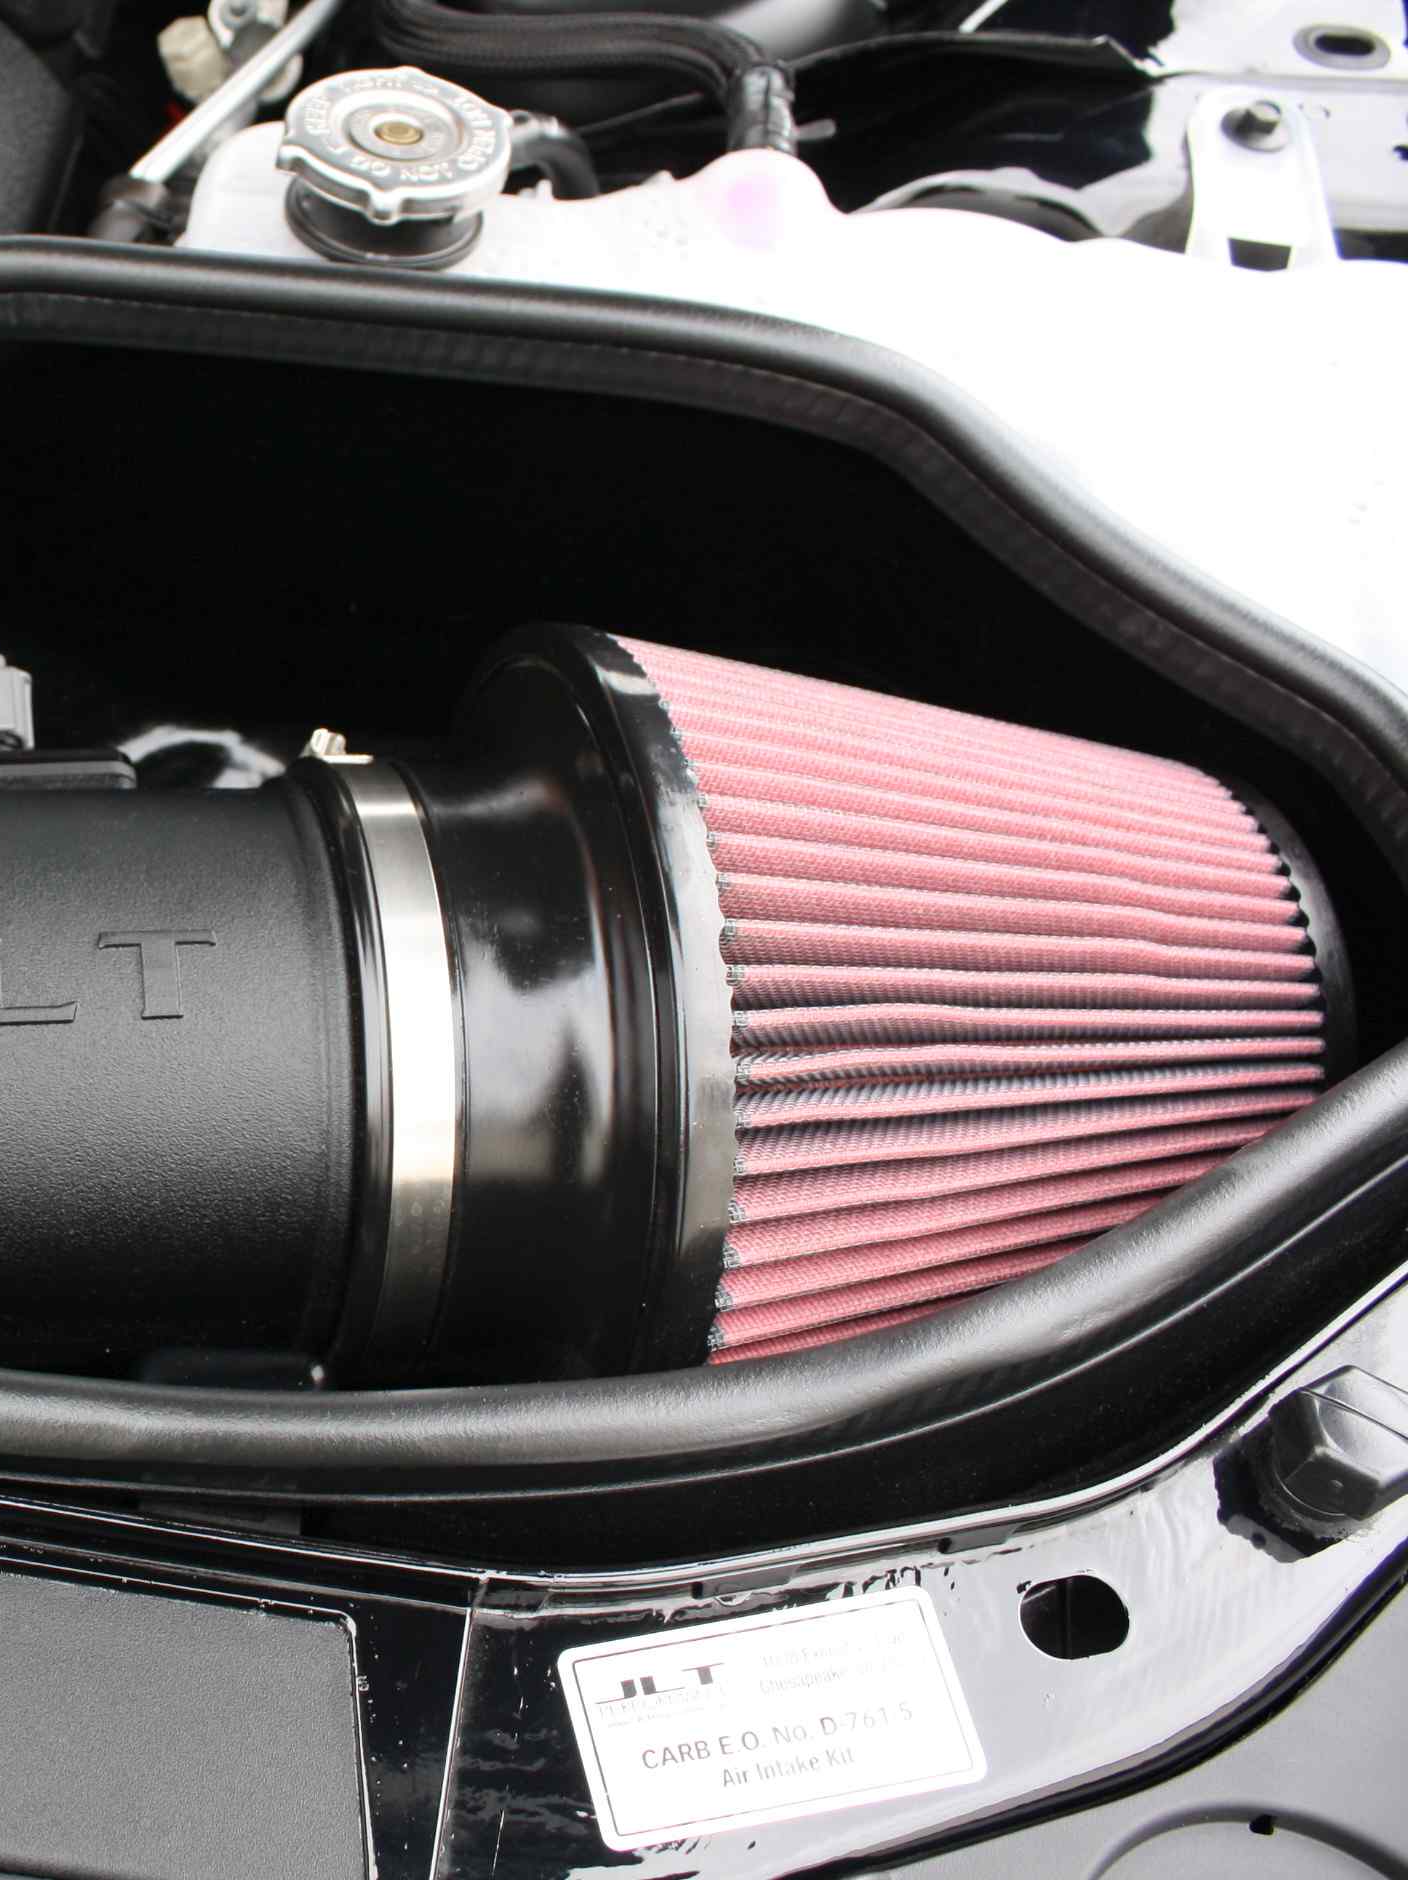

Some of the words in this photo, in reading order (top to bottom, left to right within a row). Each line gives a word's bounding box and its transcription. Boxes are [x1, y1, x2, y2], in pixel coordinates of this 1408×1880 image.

[595, 1662, 725, 1705] JLT
[641, 1740, 711, 1770] CARB
[718, 1731, 767, 1756] E.O.
[771, 1725, 815, 1745] No.
[818, 1702, 913, 1735] D-7615
[723, 1768, 749, 1788] Air
[755, 1756, 819, 1782] Intake
[825, 1747, 855, 1767] Kit
